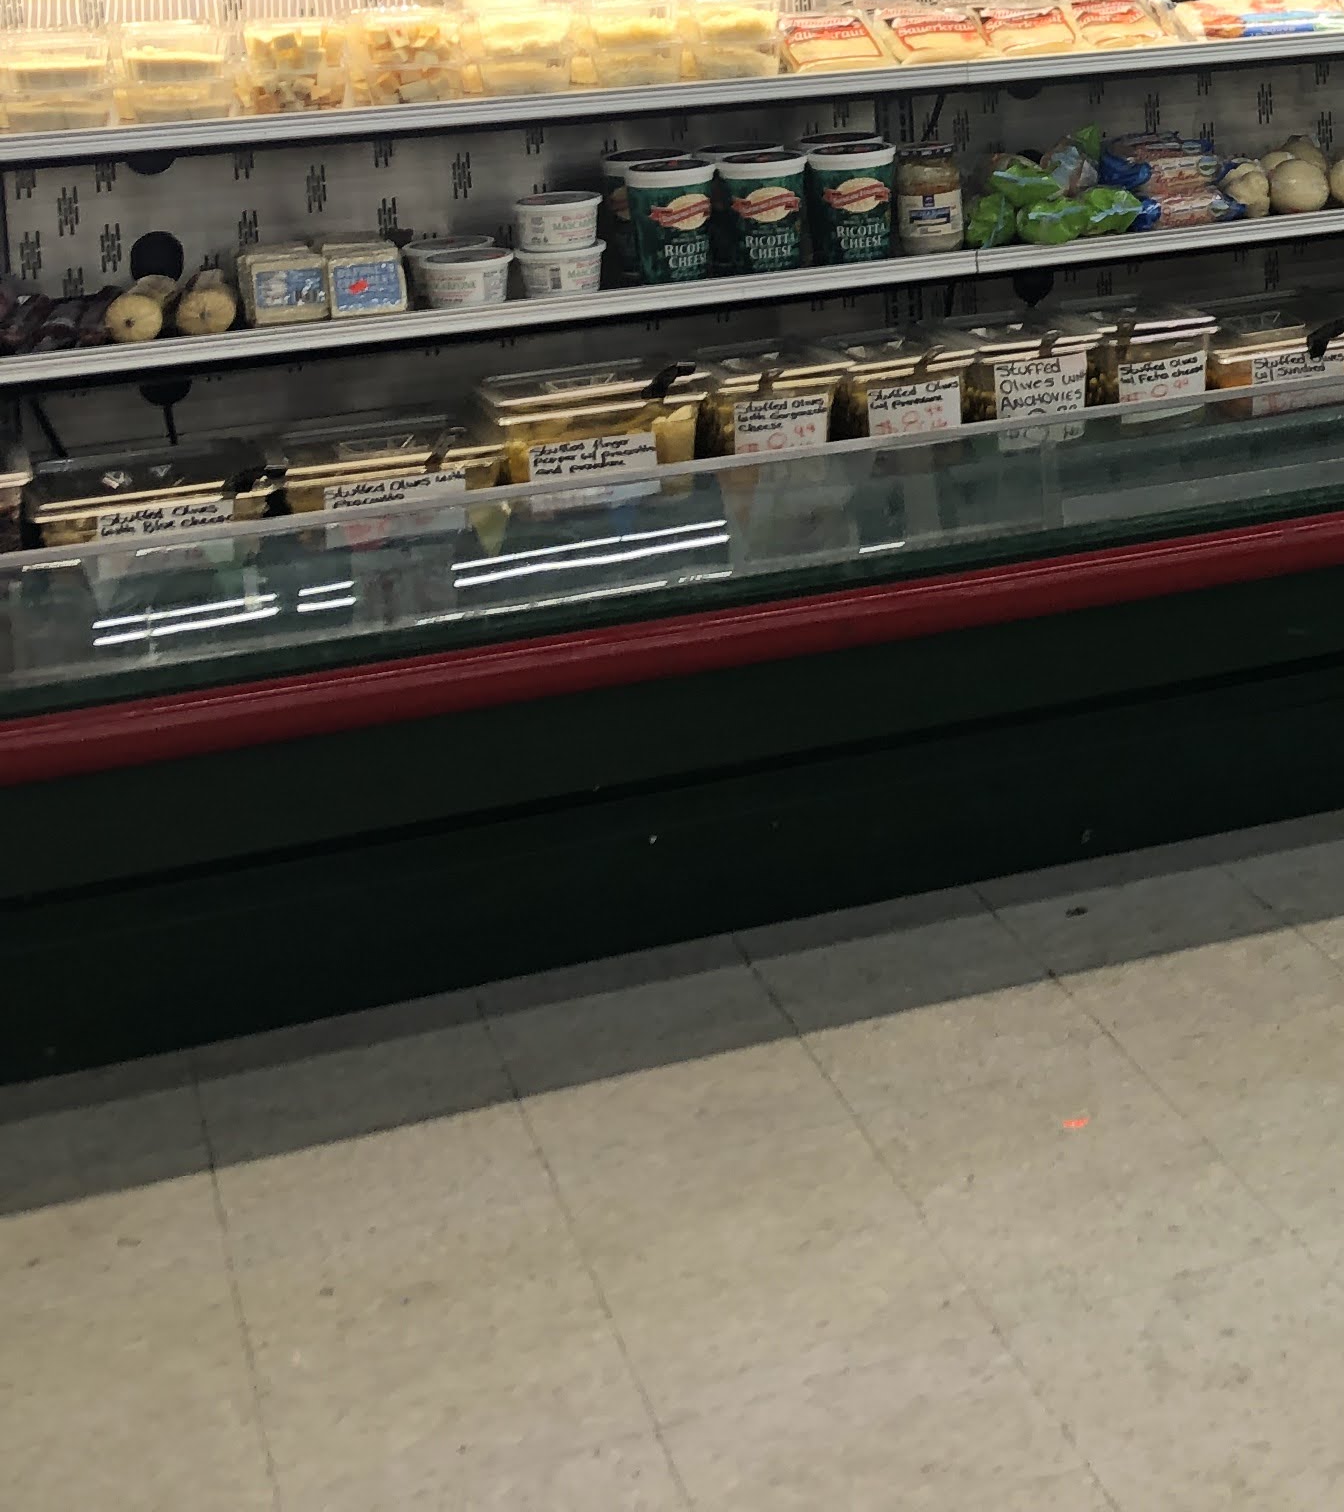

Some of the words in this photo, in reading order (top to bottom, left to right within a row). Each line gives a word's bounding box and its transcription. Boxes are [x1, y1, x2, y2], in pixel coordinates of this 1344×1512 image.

[836, 224, 886, 238] RICOTTA
[746, 234, 795, 248] RICOTTA
[840, 237, 882, 250] CHEESE
[750, 245, 792, 259] CHEESE
[1001, 389, 1082, 411] ANCHOVIES
